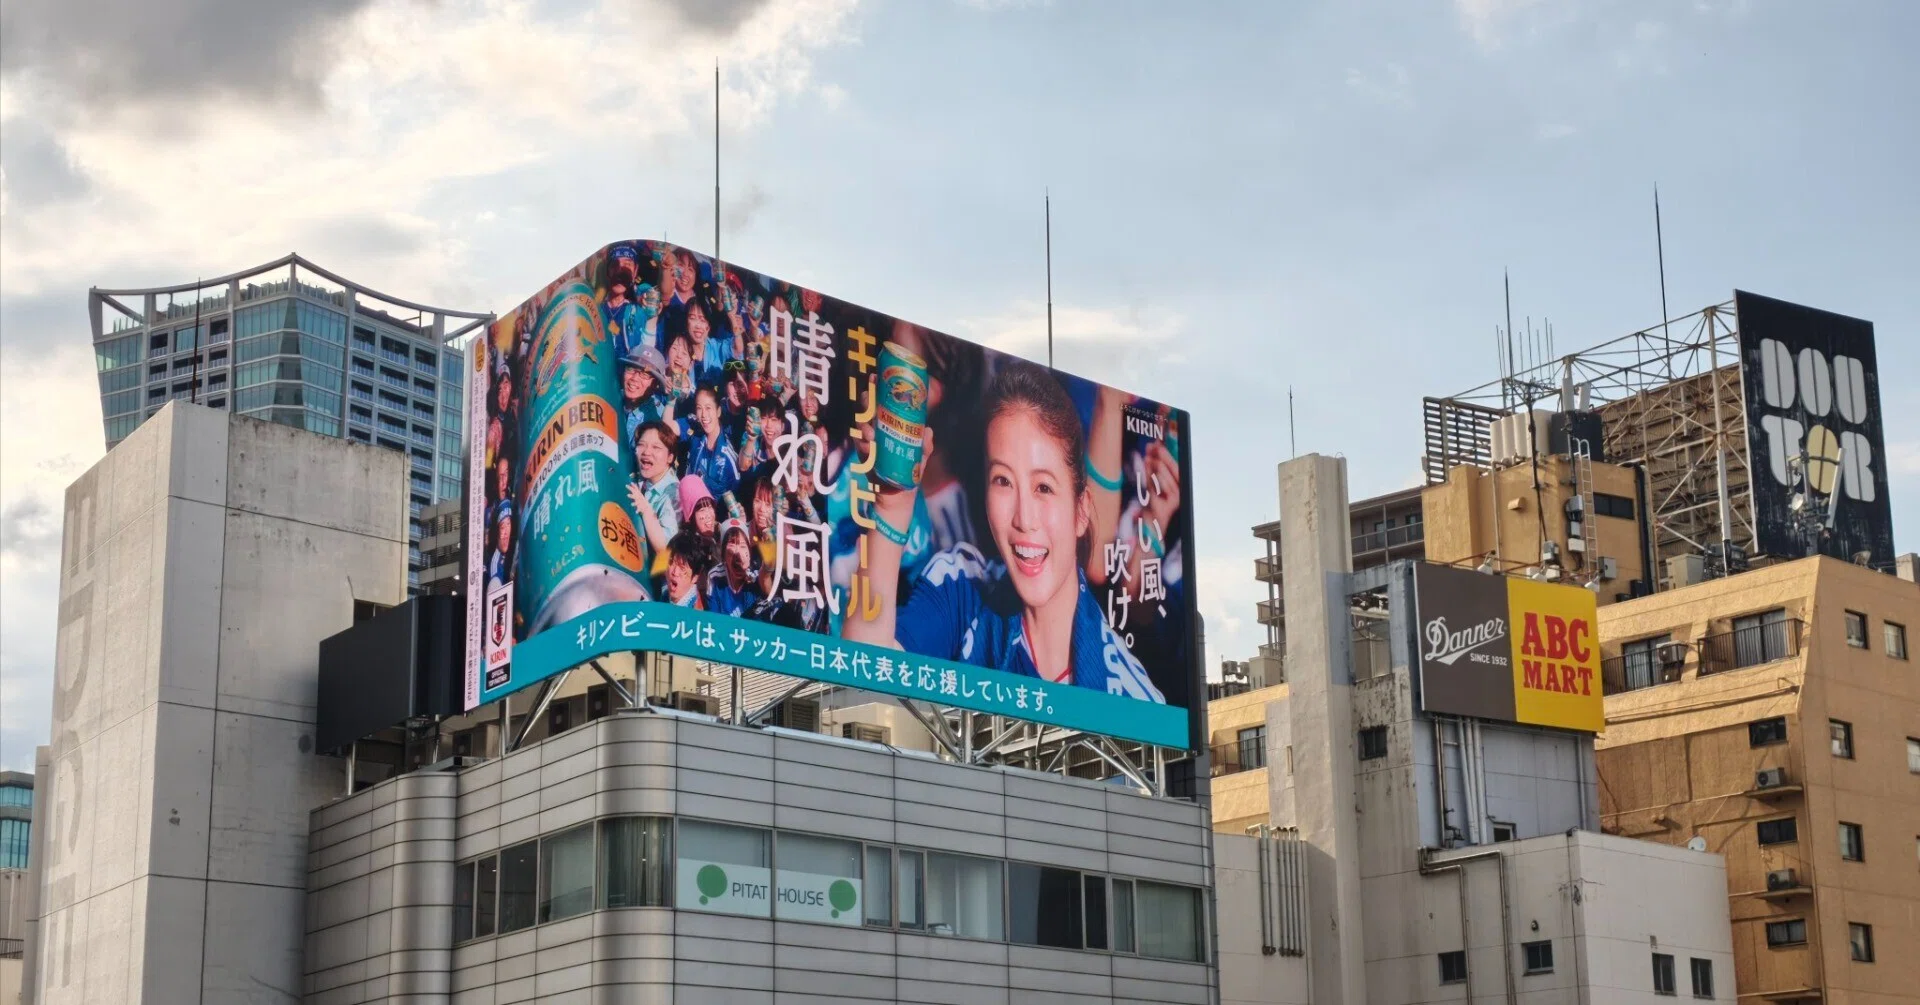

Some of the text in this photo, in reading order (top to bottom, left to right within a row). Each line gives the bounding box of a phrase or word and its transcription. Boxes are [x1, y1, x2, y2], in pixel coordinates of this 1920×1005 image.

[569, 401, 605, 428] BEER
[881, 410, 904, 431] KIRIN
[1126, 415, 1164, 441] KIRIN
[767, 305, 840, 615] 晴れ風
[847, 325, 881, 622] キリンビール
[533, 458, 599, 541] 晴れ風
[601, 516, 640, 561] お酒
[1136, 471, 1168, 619] いい風、
[1104, 538, 1135, 649] 吹け。
[490, 648, 507, 665] KIRIN
[1425, 616, 1505, 662] Danner
[1470, 653, 1508, 667] SINCE 1932
[1521, 612, 1591, 663] ABC
[576, 611, 1054, 715] キリンビールは、サッカー日本代表を応援しています。
[1521, 660, 1593, 696] MART
[732, 882, 824, 907] PITAT HOUSE
